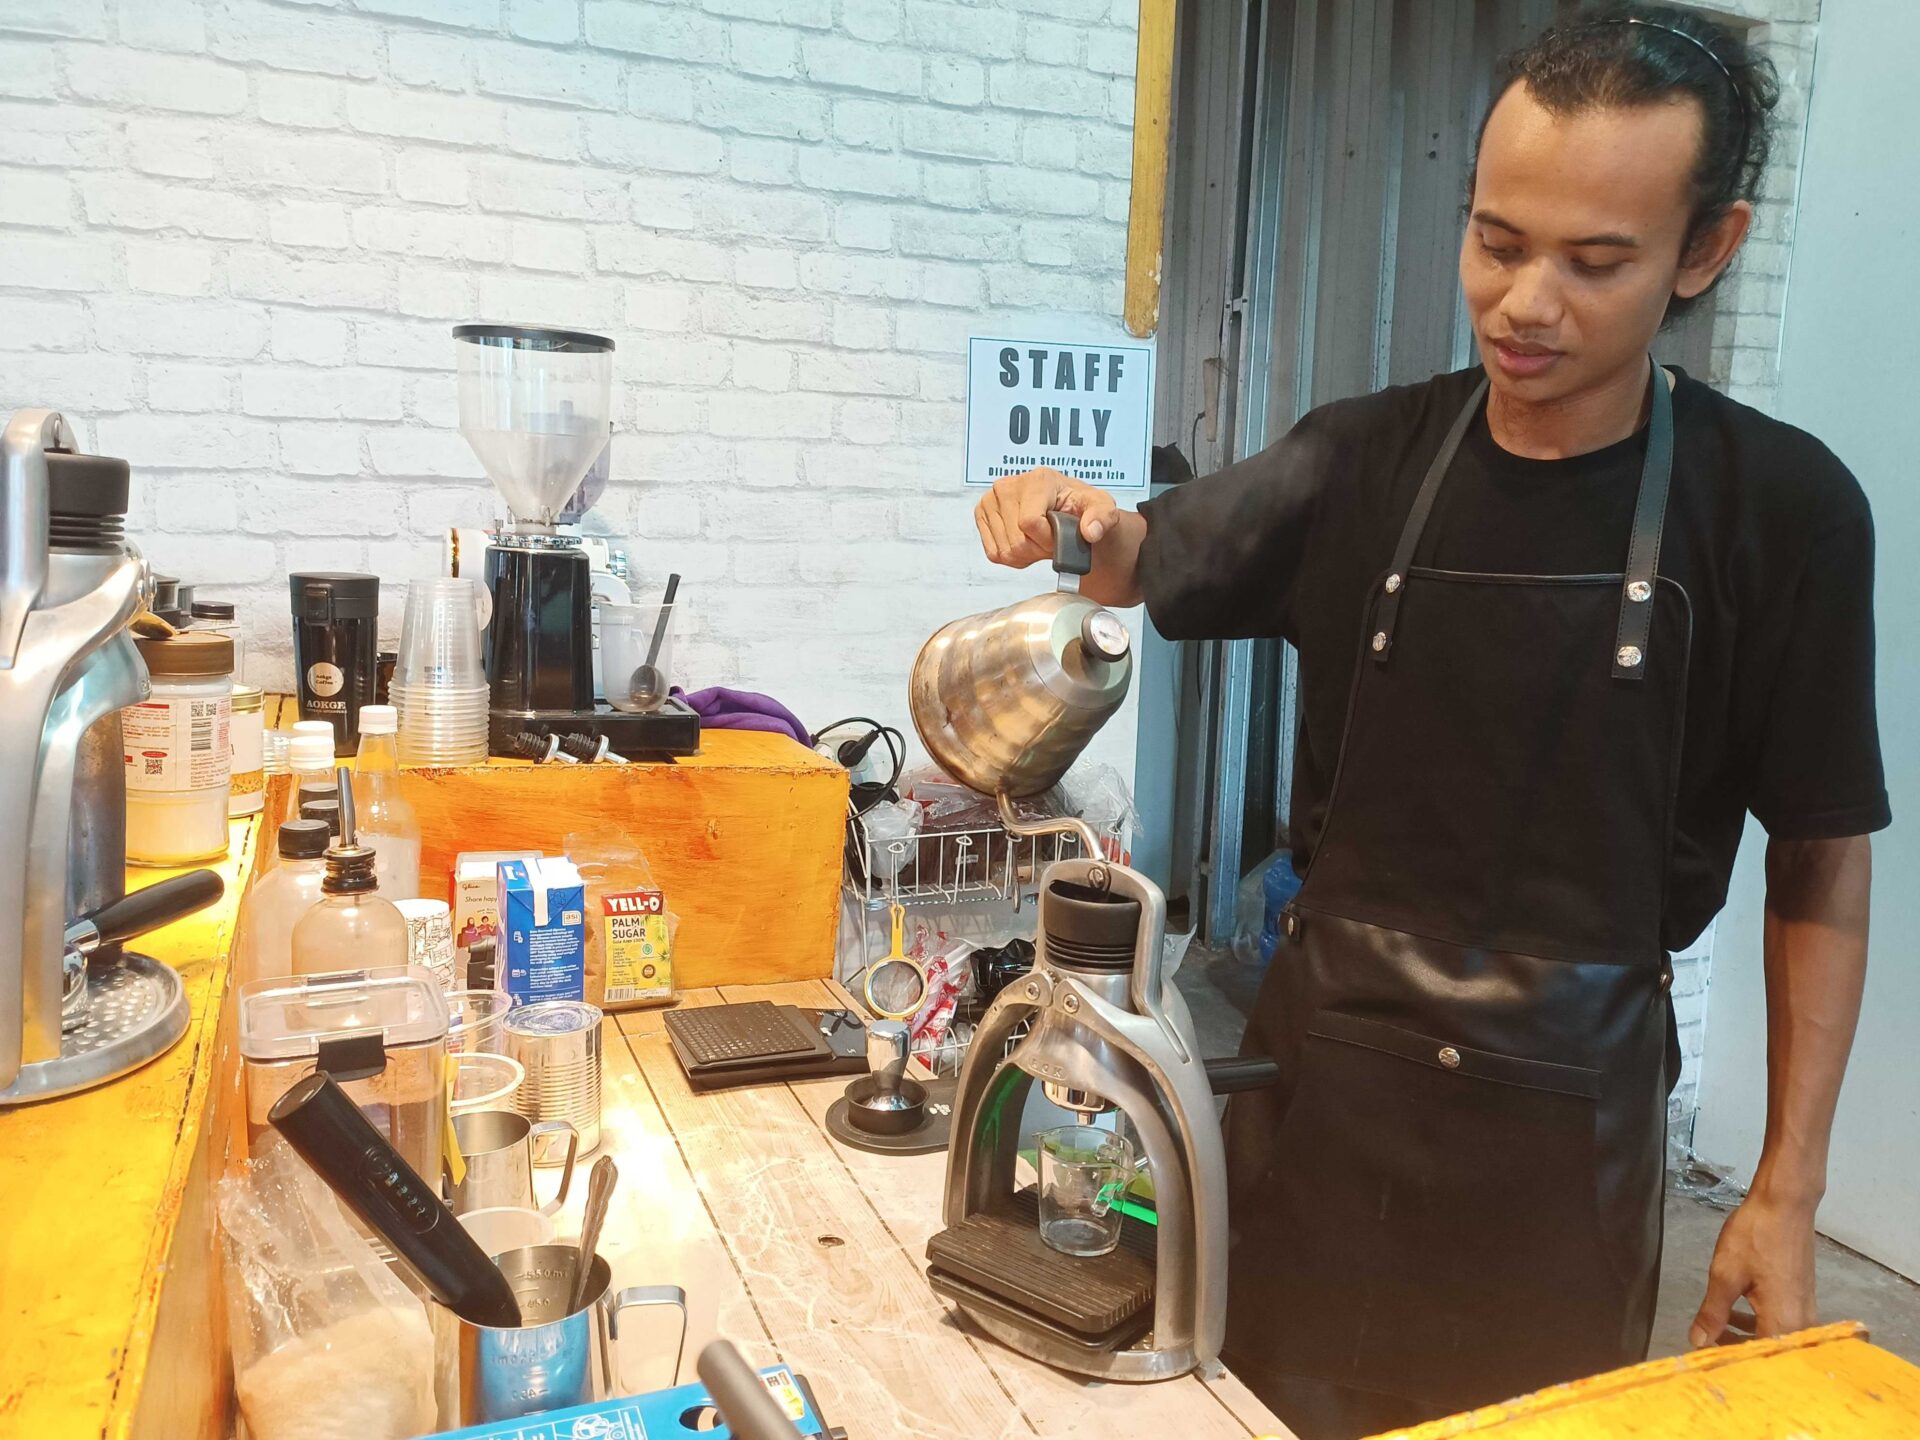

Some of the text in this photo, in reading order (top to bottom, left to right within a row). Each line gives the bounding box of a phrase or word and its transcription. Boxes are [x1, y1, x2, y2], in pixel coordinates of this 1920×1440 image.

[999, 347, 1124, 392] STAFF
[1009, 405, 1112, 447] ONLY
[1003, 455, 1112, 468] Selain Staff/Pegawai
[988, 467, 1032, 477] Dilara
[1073, 469, 1103, 480] Tanpa
[307, 700, 346, 710] AOKGE
[607, 896, 660, 912] YELL-O
[611, 917, 640, 928] PALM
[612, 928, 646, 939] SUGAR
